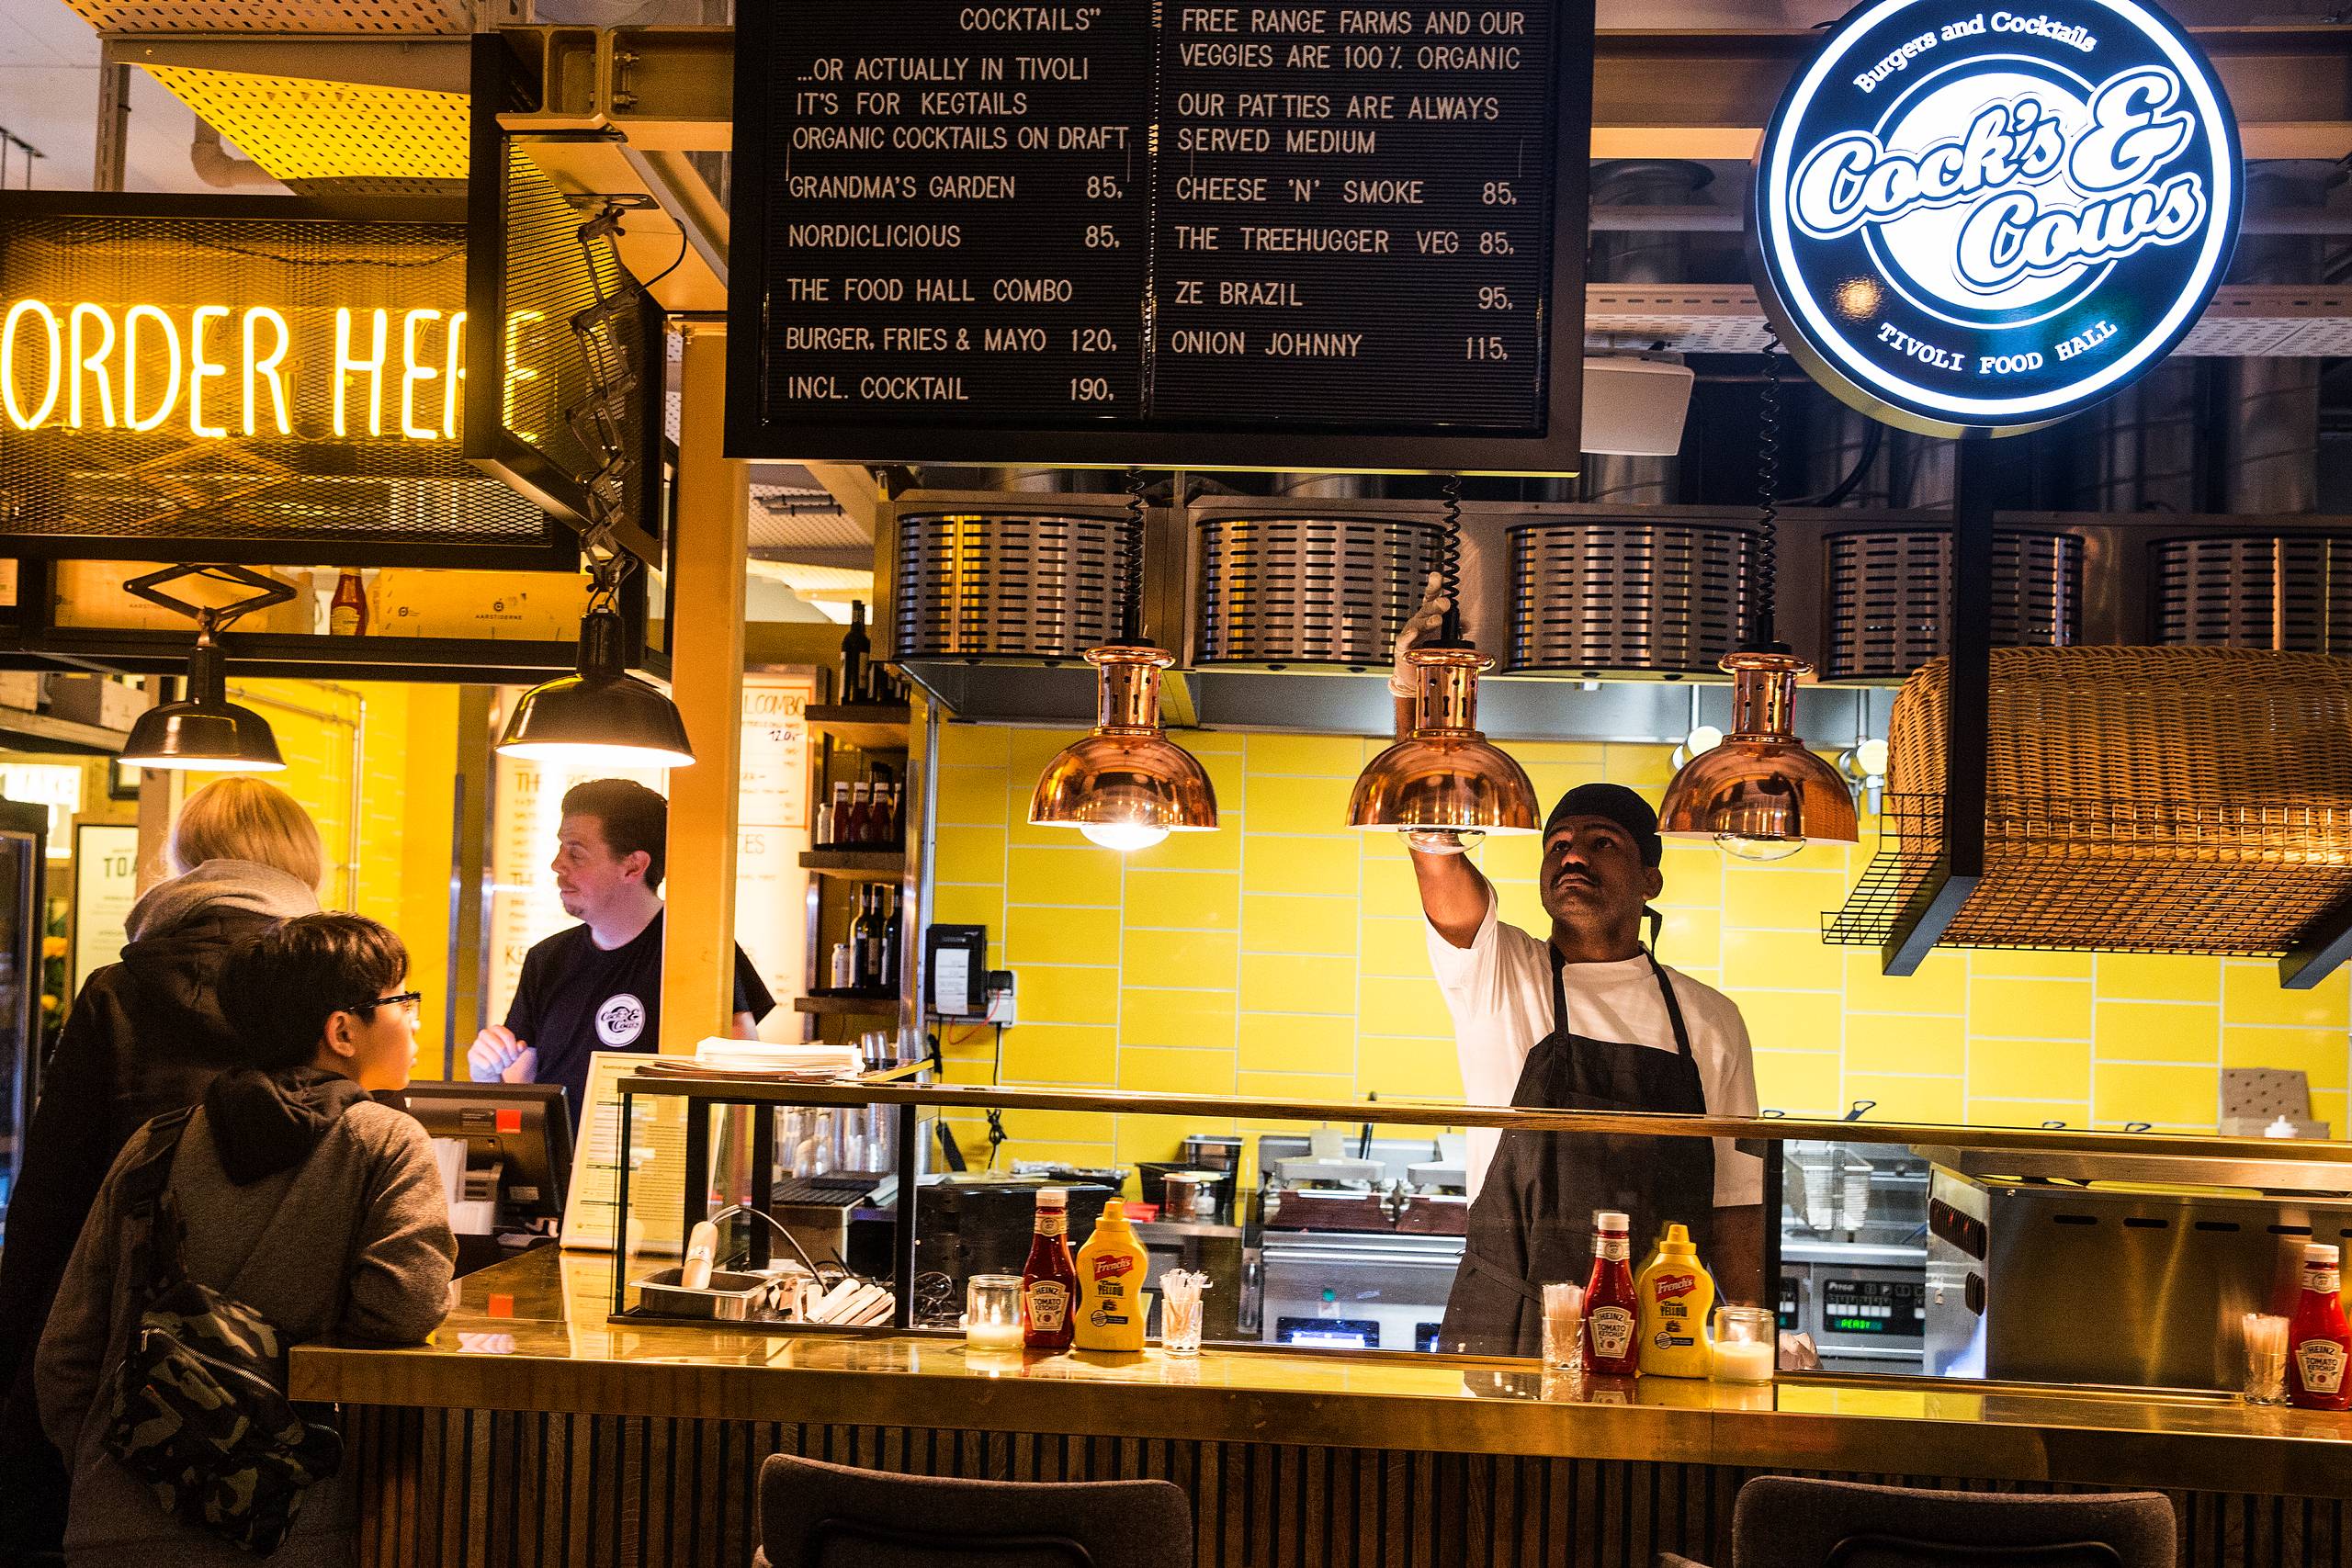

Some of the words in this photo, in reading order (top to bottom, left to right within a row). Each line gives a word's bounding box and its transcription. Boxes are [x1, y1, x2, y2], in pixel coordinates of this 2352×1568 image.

[1182, 9, 1238, 31] FREE
[1252, 10, 1326, 33] RANGE
[1340, 11, 1411, 34] FARMS
[1425, 12, 1470, 34] AND
[1480, 12, 1523, 34] OUR
[1181, 44, 1272, 67] VEGGIES
[1287, 45, 1330, 68] ARE
[1418, 47, 1520, 69] ORGANIC
[1852, 31, 1938, 93] Burgers
[1940, 13, 1986, 42] and
[1990, 11, 2098, 53] Cocktails
[855, 58, 968, 80] ACTUALLY
[982, 59, 1002, 80] IN
[1016, 58, 1087, 80] TIVOLI
[797, 93, 838, 115] IT'S
[858, 93, 899, 115] FOR
[922, 92, 1026, 114] KEGTAILS
[1179, 94, 1224, 116] OUR
[1347, 96, 1394, 118] ARE
[1408, 96, 1498, 119] ALWAYS
[794, 127, 884, 149] ORGANIC
[893, 127, 1007, 149] COCKTAILS
[1018, 127, 1047, 149] ON
[1058, 127, 1128, 149] DRAFT
[1178, 129, 1270, 152] SERVED
[1287, 130, 1374, 153] MEDIUM
[1791, 95, 2067, 231] Cock's
[787, 174, 916, 198] GRANDMA'S
[930, 176, 1014, 198] GARDEN
[1177, 177, 1267, 200] CHEESE
[1344, 181, 1423, 203] SMOKE
[790, 225, 960, 247] NORDICLICIOUS
[1175, 227, 1218, 250] THE
[1240, 228, 1388, 253] TREEHUGGER
[1417, 231, 1458, 254] VEG
[1955, 176, 2202, 288] Cows
[787, 278, 829, 300] THE
[845, 279, 902, 300] FOOD
[917, 279, 975, 301] HALL
[994, 279, 1072, 301] COMBO
[1176, 281, 1203, 303] ZE
[1220, 282, 1302, 305] BRAZIL
[786, 328, 874, 350] BURGER,
[885, 328, 947, 350] FRIES
[956, 328, 969, 350] &
[985, 329, 1046, 351] MAYO
[1172, 331, 1244, 354] ONION
[1265, 333, 1362, 356] JOHNNY
[1877, 321, 1964, 372] TIVOLI
[1979, 352, 2044, 375] FOOD
[2054, 320, 2119, 362] HALL
[2, 299, 292, 437] ORDER
[789, 377, 848, 399] INCL.
[861, 378, 968, 400] COCKTAIL
[1096, 1258, 1131, 1273] French's
[1035, 1286, 1058, 1295] HEINZ
[1657, 1277, 1692, 1293] French's
[1600, 1313, 1623, 1322] HEINZ
[1660, 1305, 1687, 1316] YELLOW
[1598, 1324, 1626, 1332] TOMATO
[2306, 1357, 2337, 1366] TOMATO
[2308, 1346, 2335, 1355] HEINZ
